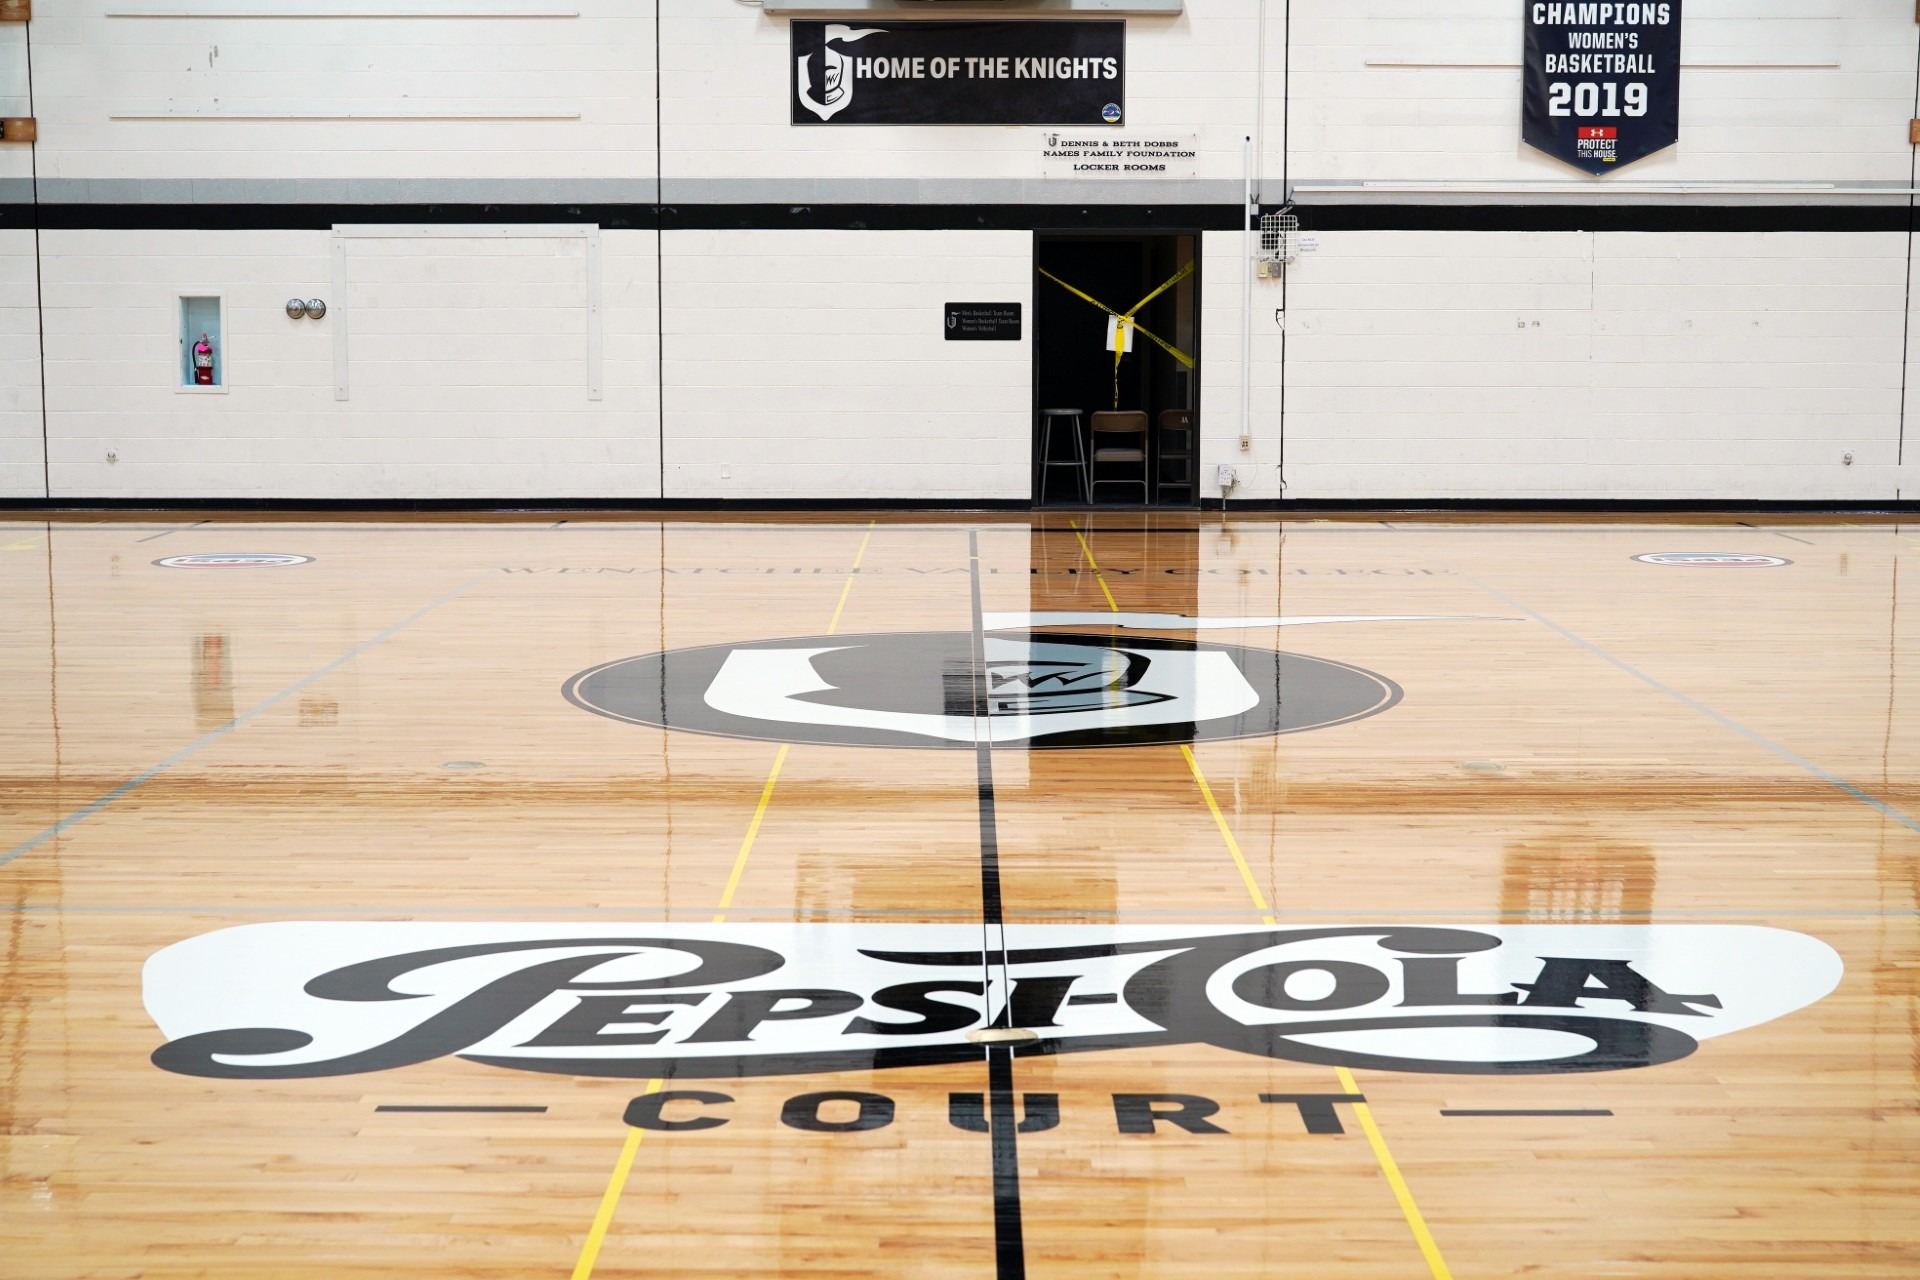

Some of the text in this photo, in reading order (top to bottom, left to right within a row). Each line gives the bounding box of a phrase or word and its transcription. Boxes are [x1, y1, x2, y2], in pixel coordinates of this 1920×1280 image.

[1533, 3, 1671, 25] CHAMPIONS
[1568, 32, 1639, 50] WOMEN'S
[856, 57, 1118, 80] HOME OF THE KNIGHTS
[1545, 54, 1656, 74] BASKETBALL
[1548, 82, 1648, 117] 2019
[1060, 140, 1179, 148] DENNIS & BETH DOBBS
[1577, 139, 1616, 150] PROTECT
[1577, 149, 1593, 158] THIS
[1043, 150, 1196, 158] NAMES FAMILY FOUNDATION
[622, 1090, 1367, 1134] COURT
